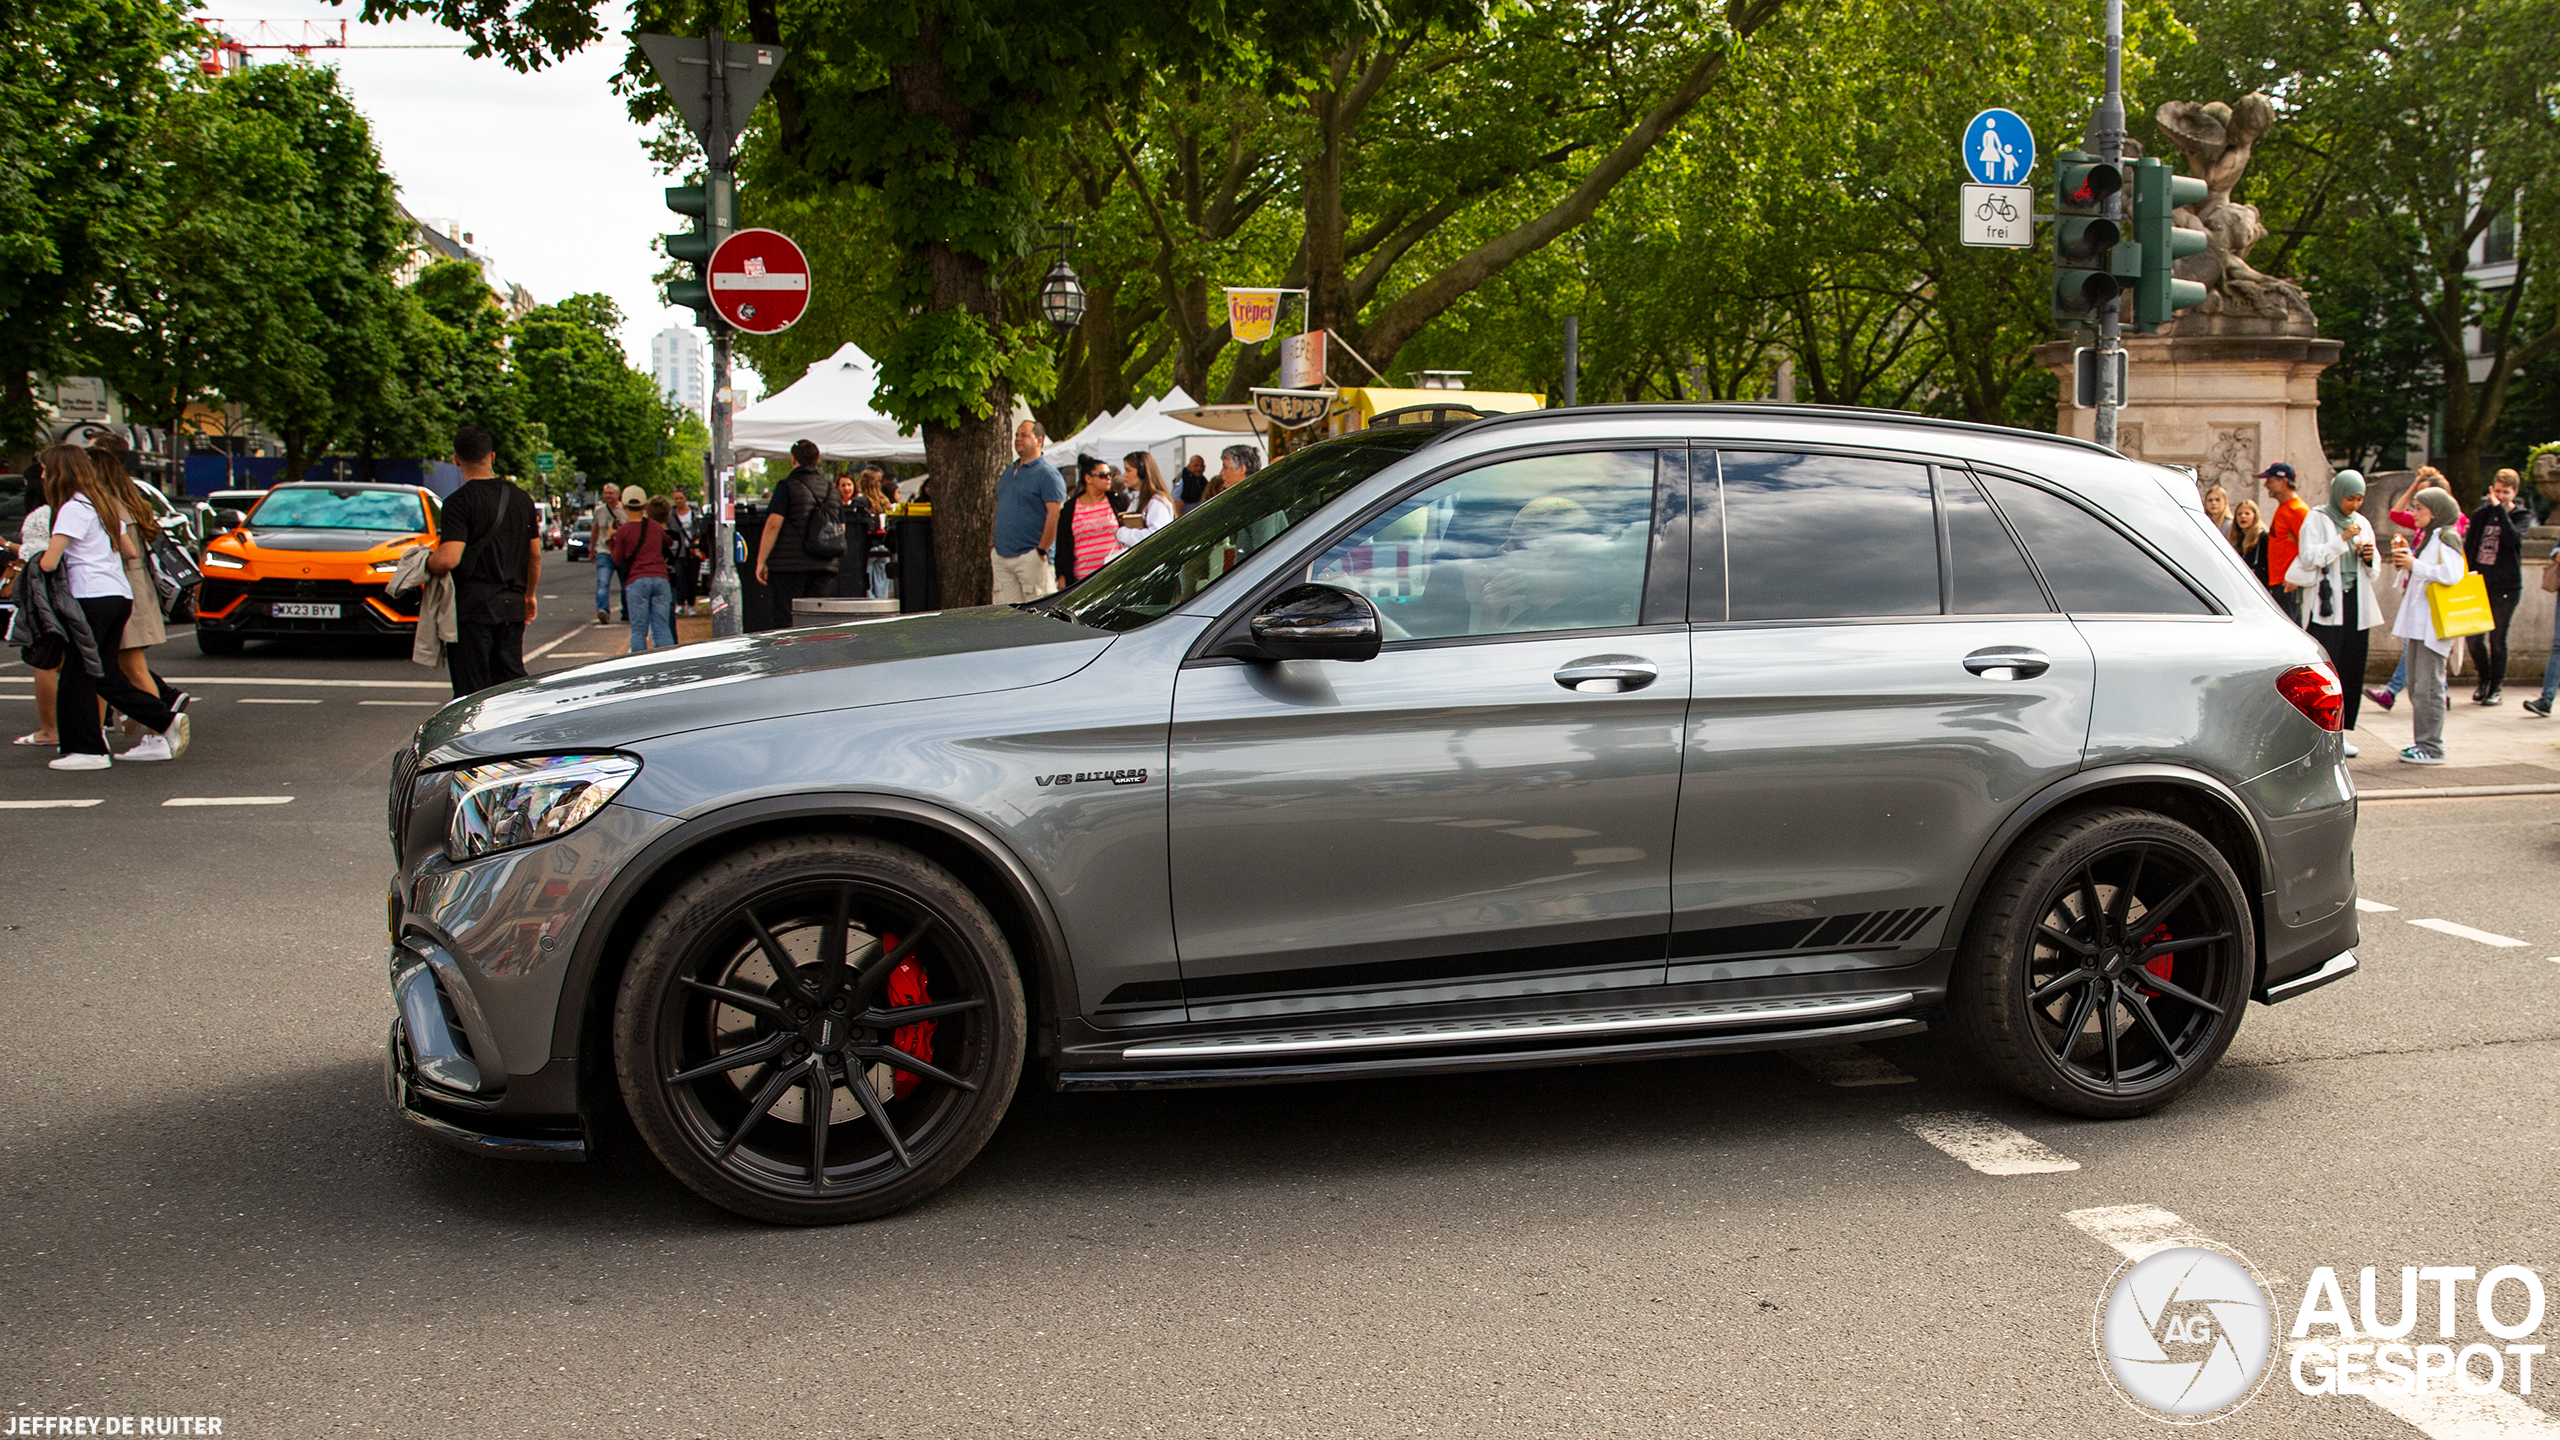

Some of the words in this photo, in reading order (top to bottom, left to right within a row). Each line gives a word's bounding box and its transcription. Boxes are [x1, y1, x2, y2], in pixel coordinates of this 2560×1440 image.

[1986, 225, 2009, 239] frei
[1232, 301, 1274, 324] Crêpes
[312, 605, 336, 616] BYY
[1035, 773, 1073, 786] V8
[1075, 768, 1148, 781] BITURBO
